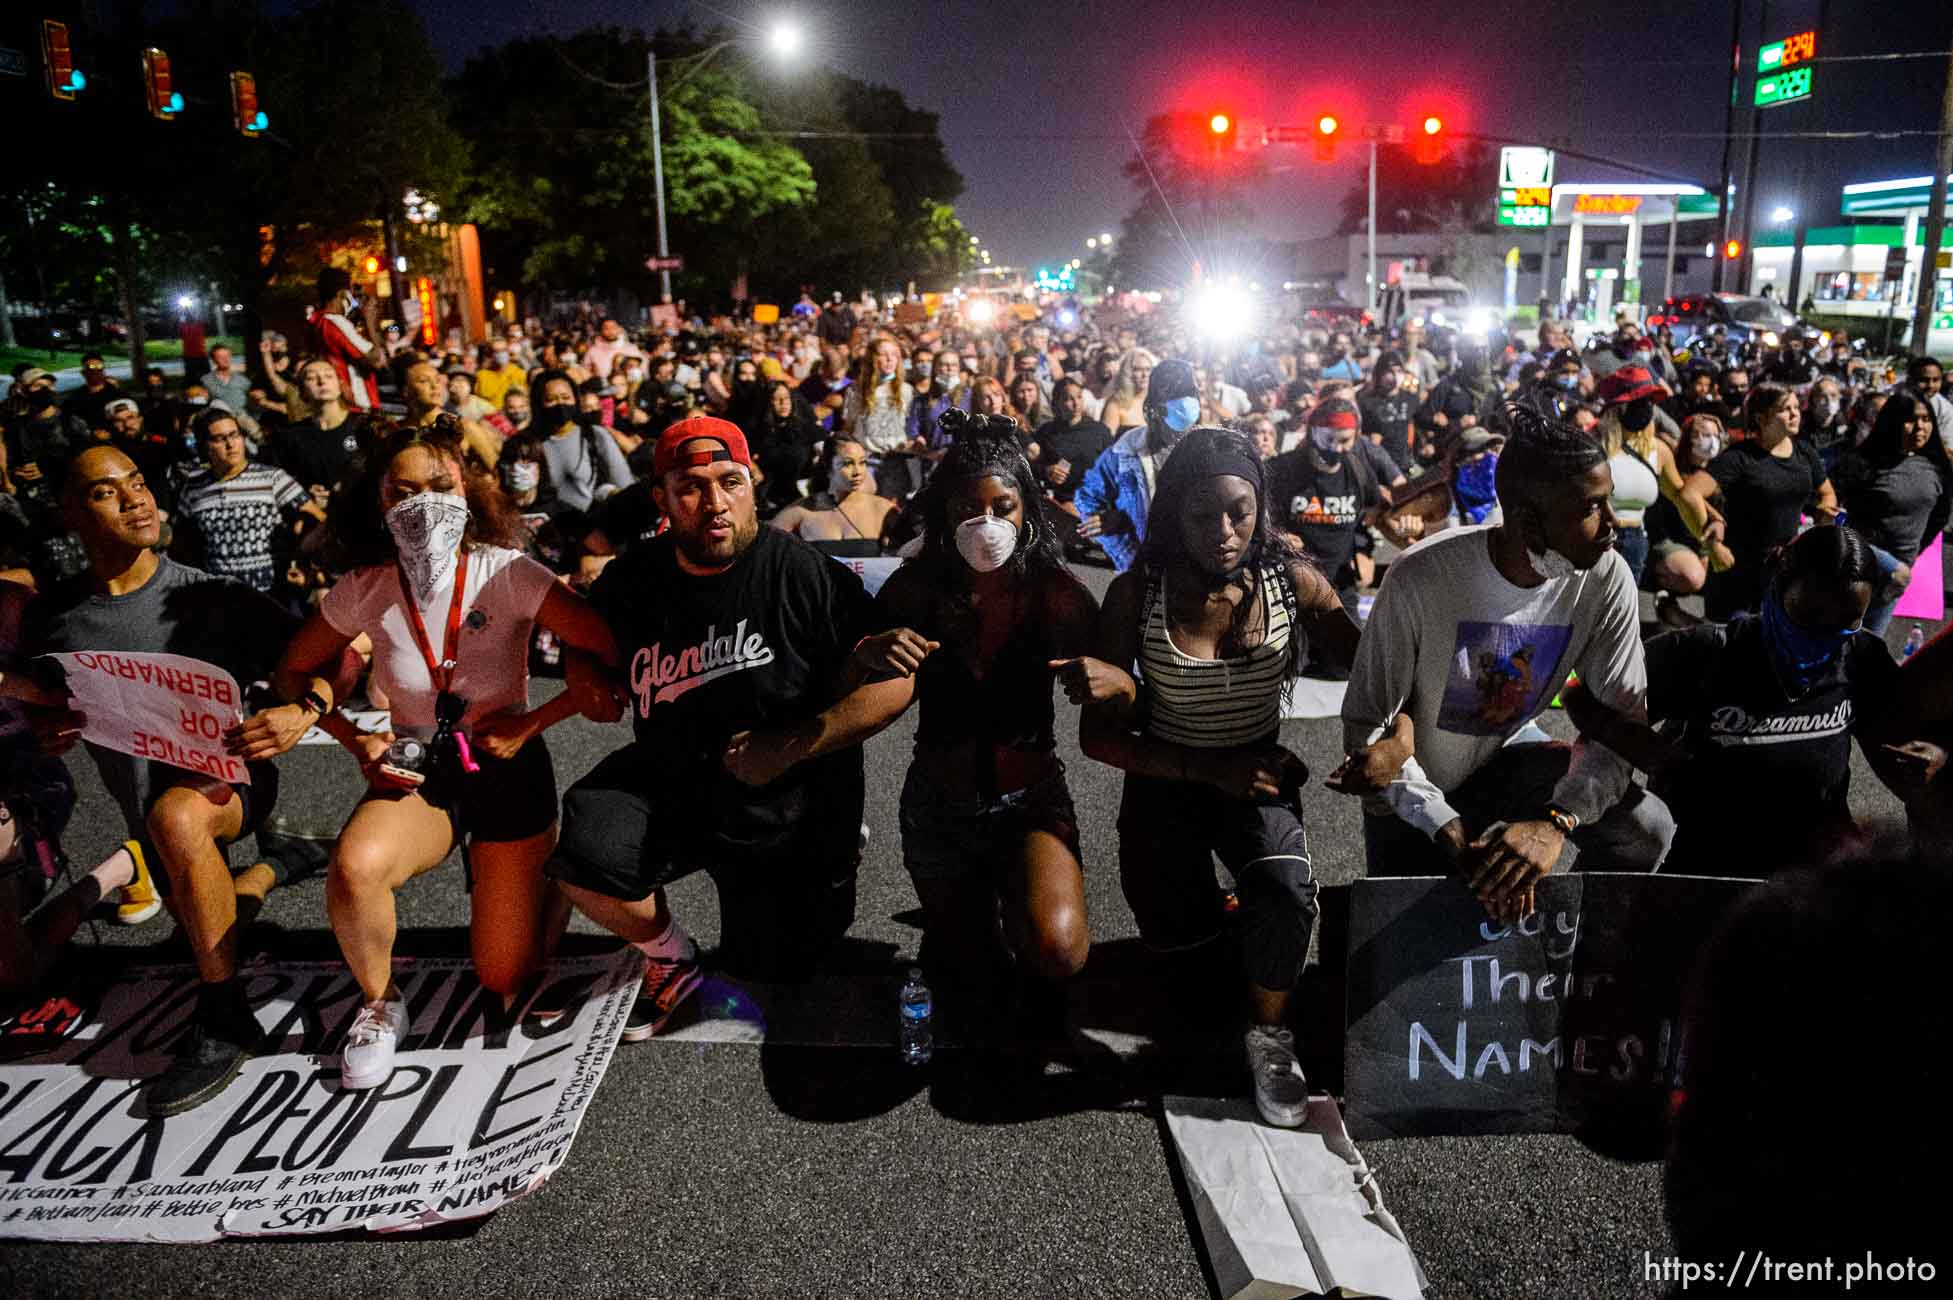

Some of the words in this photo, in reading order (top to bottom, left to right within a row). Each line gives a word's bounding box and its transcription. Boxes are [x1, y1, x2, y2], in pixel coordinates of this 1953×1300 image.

[1290, 495, 1357, 515] PARK
[74, 652, 233, 705] BERNARDO
[631, 618, 772, 718] Glendale
[180, 709, 236, 740] OR
[133, 730, 240, 780] JUSTICE
[180, 1042, 573, 1178] PEOPLE
[262, 1204, 342, 1230] SAY
[341, 1199, 428, 1222] THEIR
